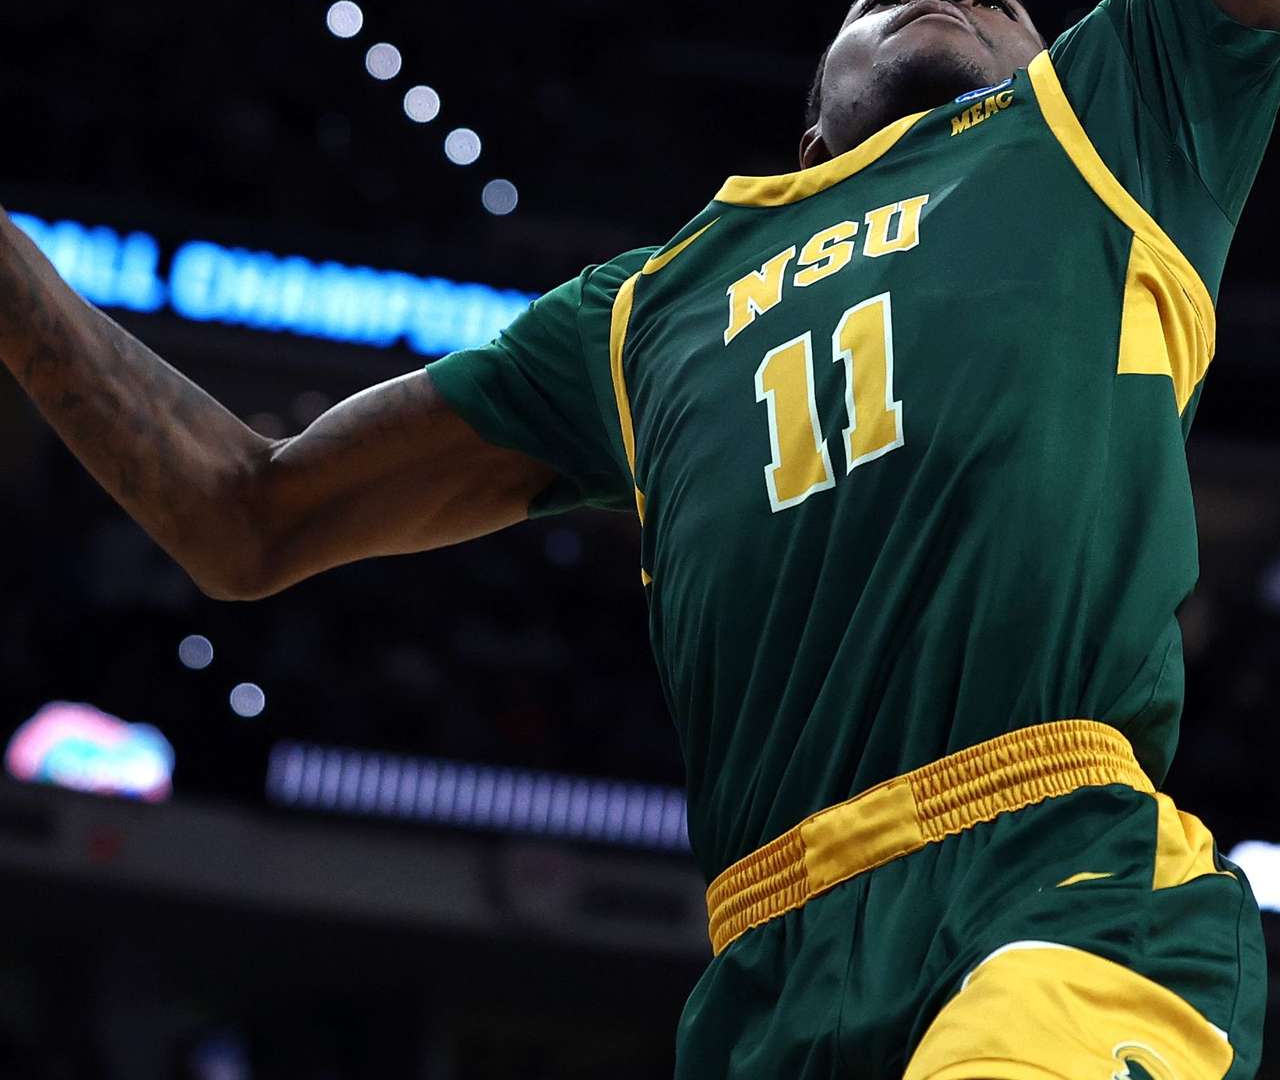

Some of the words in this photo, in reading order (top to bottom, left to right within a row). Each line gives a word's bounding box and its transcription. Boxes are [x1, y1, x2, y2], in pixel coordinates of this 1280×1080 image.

[950, 89, 1015, 137] MEAC
[723, 193, 930, 347] NSU
[754, 290, 905, 514] 11
